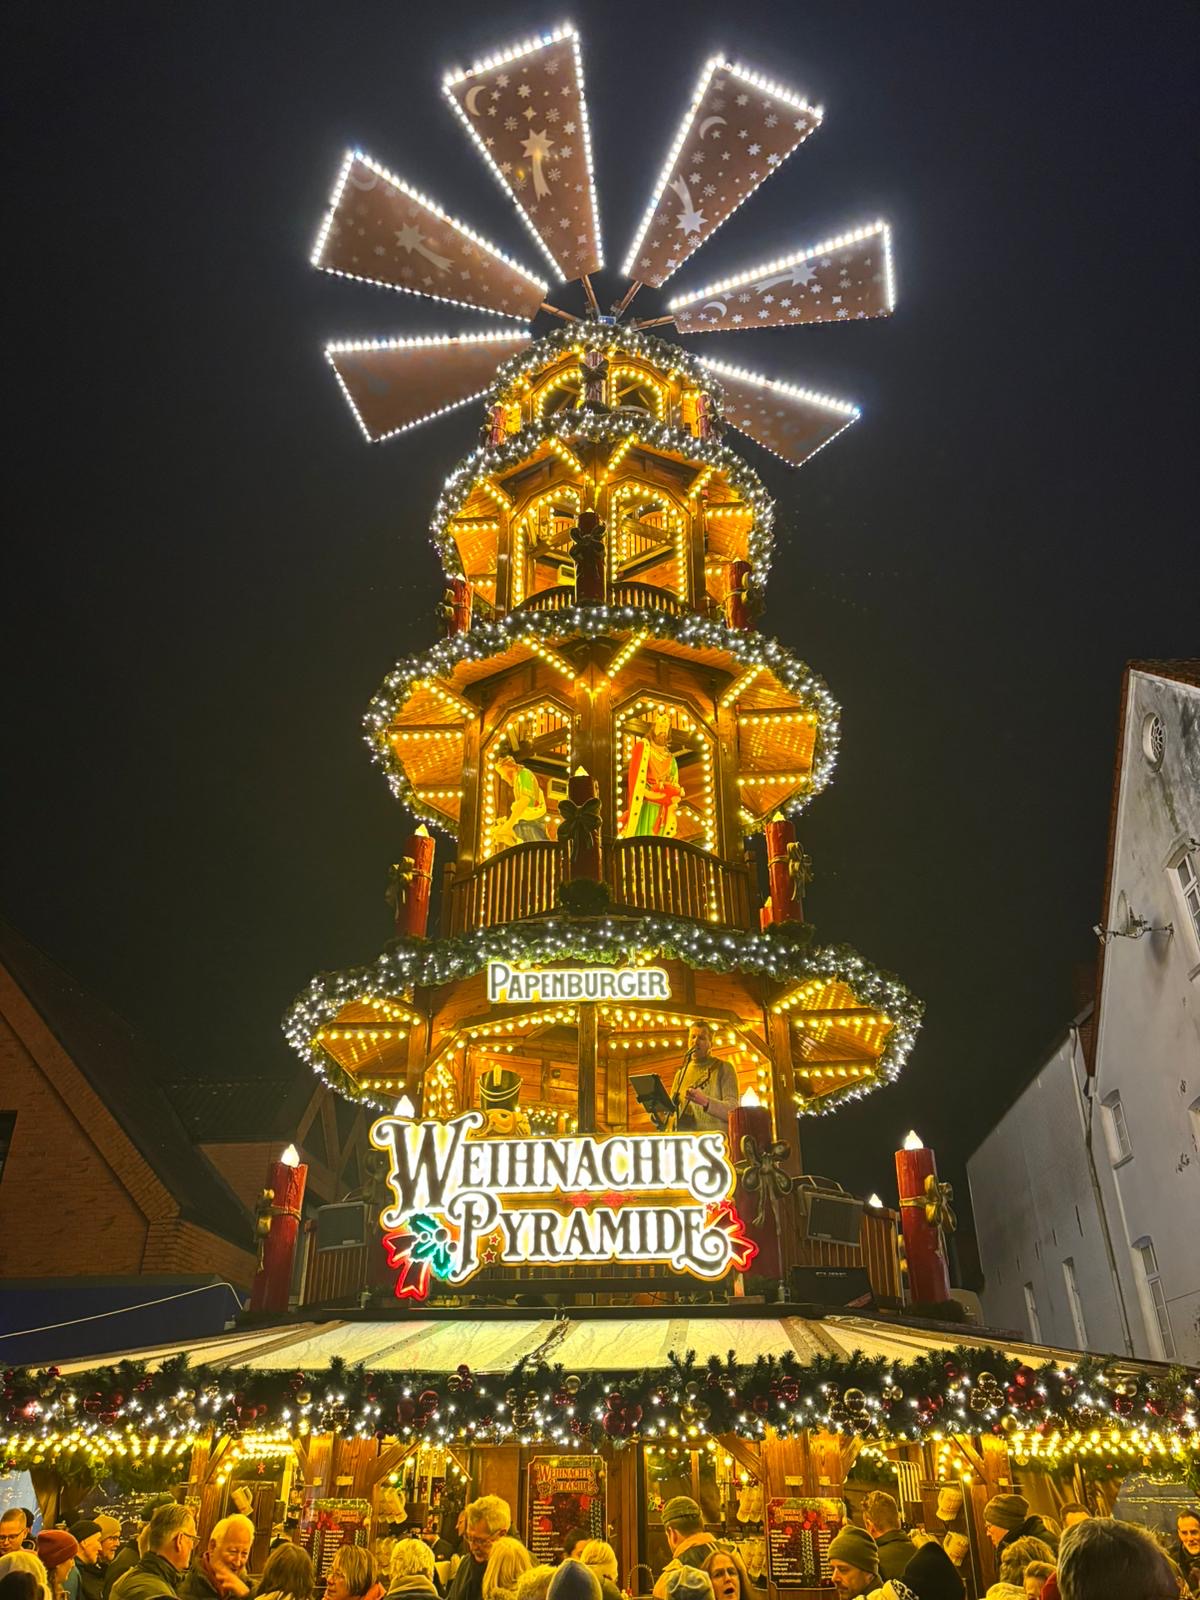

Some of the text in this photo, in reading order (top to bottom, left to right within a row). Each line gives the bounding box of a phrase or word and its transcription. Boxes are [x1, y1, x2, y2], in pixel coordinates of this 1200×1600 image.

[490, 963, 667, 999] PAPENBURGER
[375, 1111, 729, 1225] WEIHNACHTS
[447, 1191, 729, 1280] PYRAMIDE
